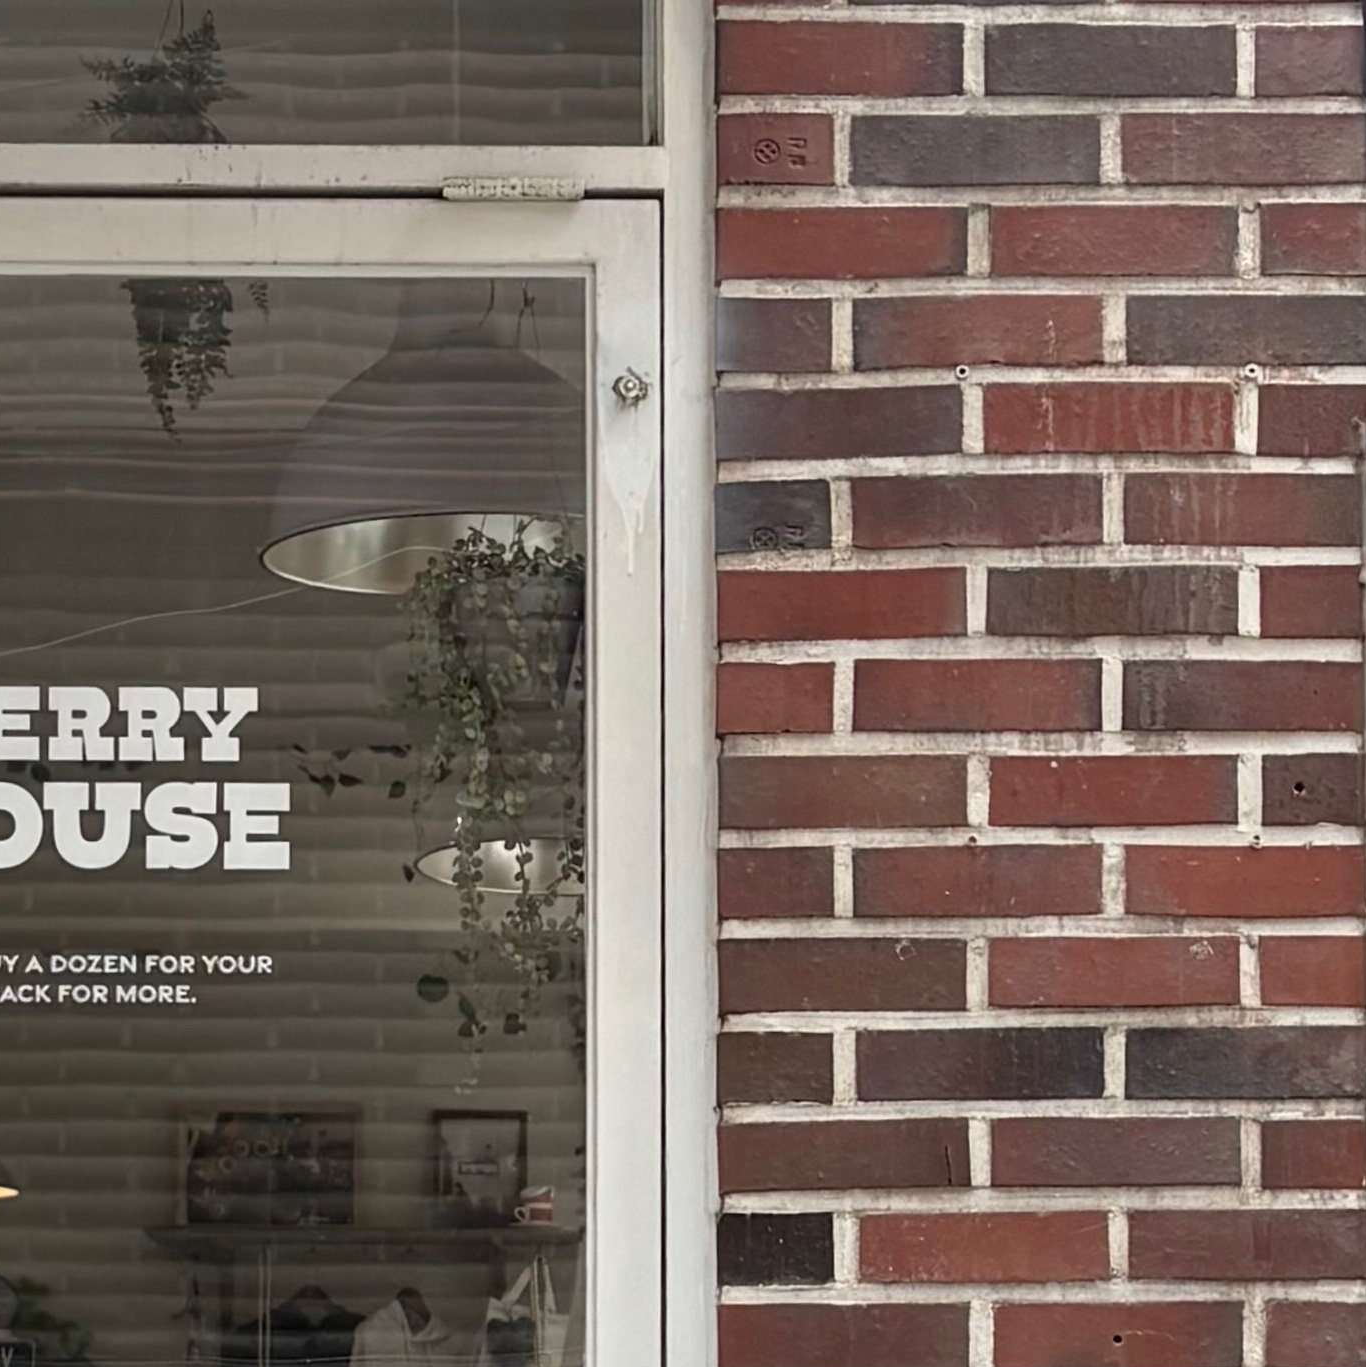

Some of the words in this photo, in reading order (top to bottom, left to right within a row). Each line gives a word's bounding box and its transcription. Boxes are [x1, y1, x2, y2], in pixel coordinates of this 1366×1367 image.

[24, 955, 44, 973] A
[50, 954, 137, 973] DOZEN
[145, 955, 195, 974] FOR
[201, 955, 273, 974] YOUR
[58, 984, 109, 1003] FOR
[116, 984, 197, 1003] MORE.
